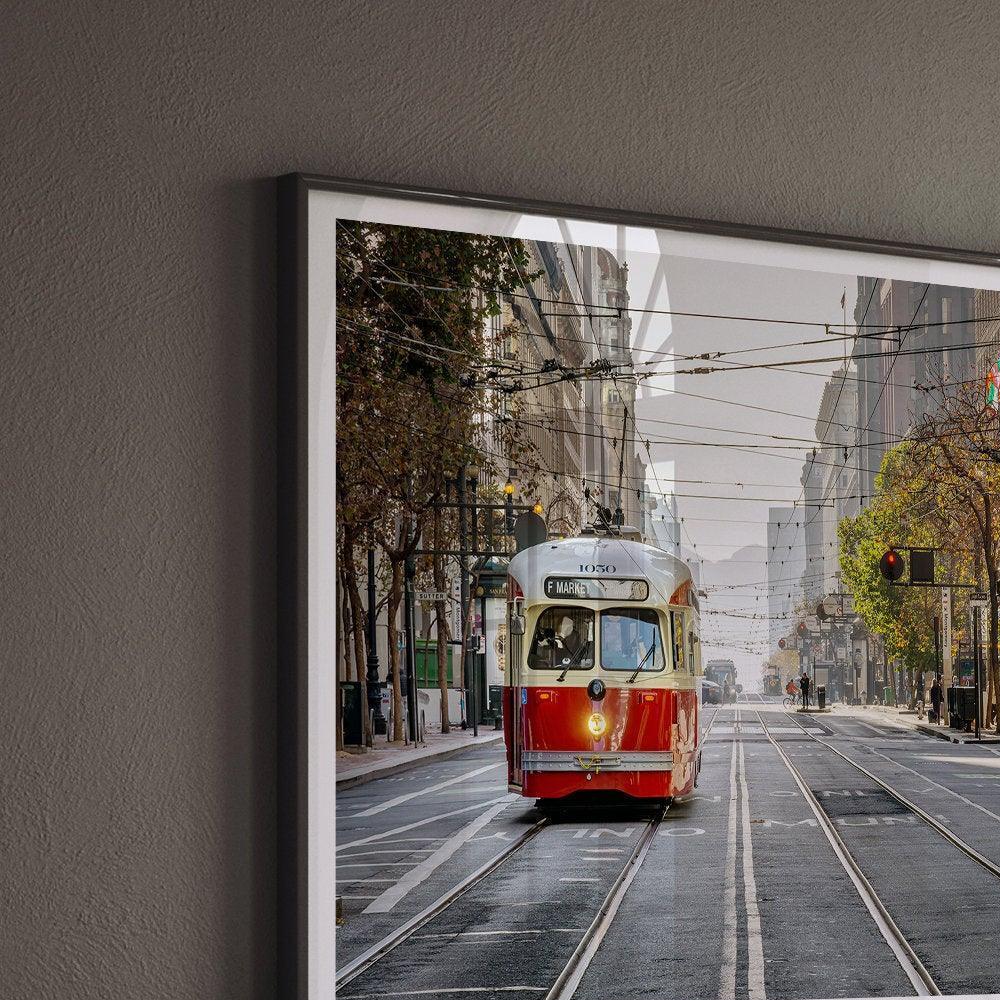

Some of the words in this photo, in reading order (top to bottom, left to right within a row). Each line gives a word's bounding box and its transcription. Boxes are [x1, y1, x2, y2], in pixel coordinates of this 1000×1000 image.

[579, 564, 617, 574] 1050
[547, 581, 553, 593] F
[556, 581, 590, 595] MARKET
